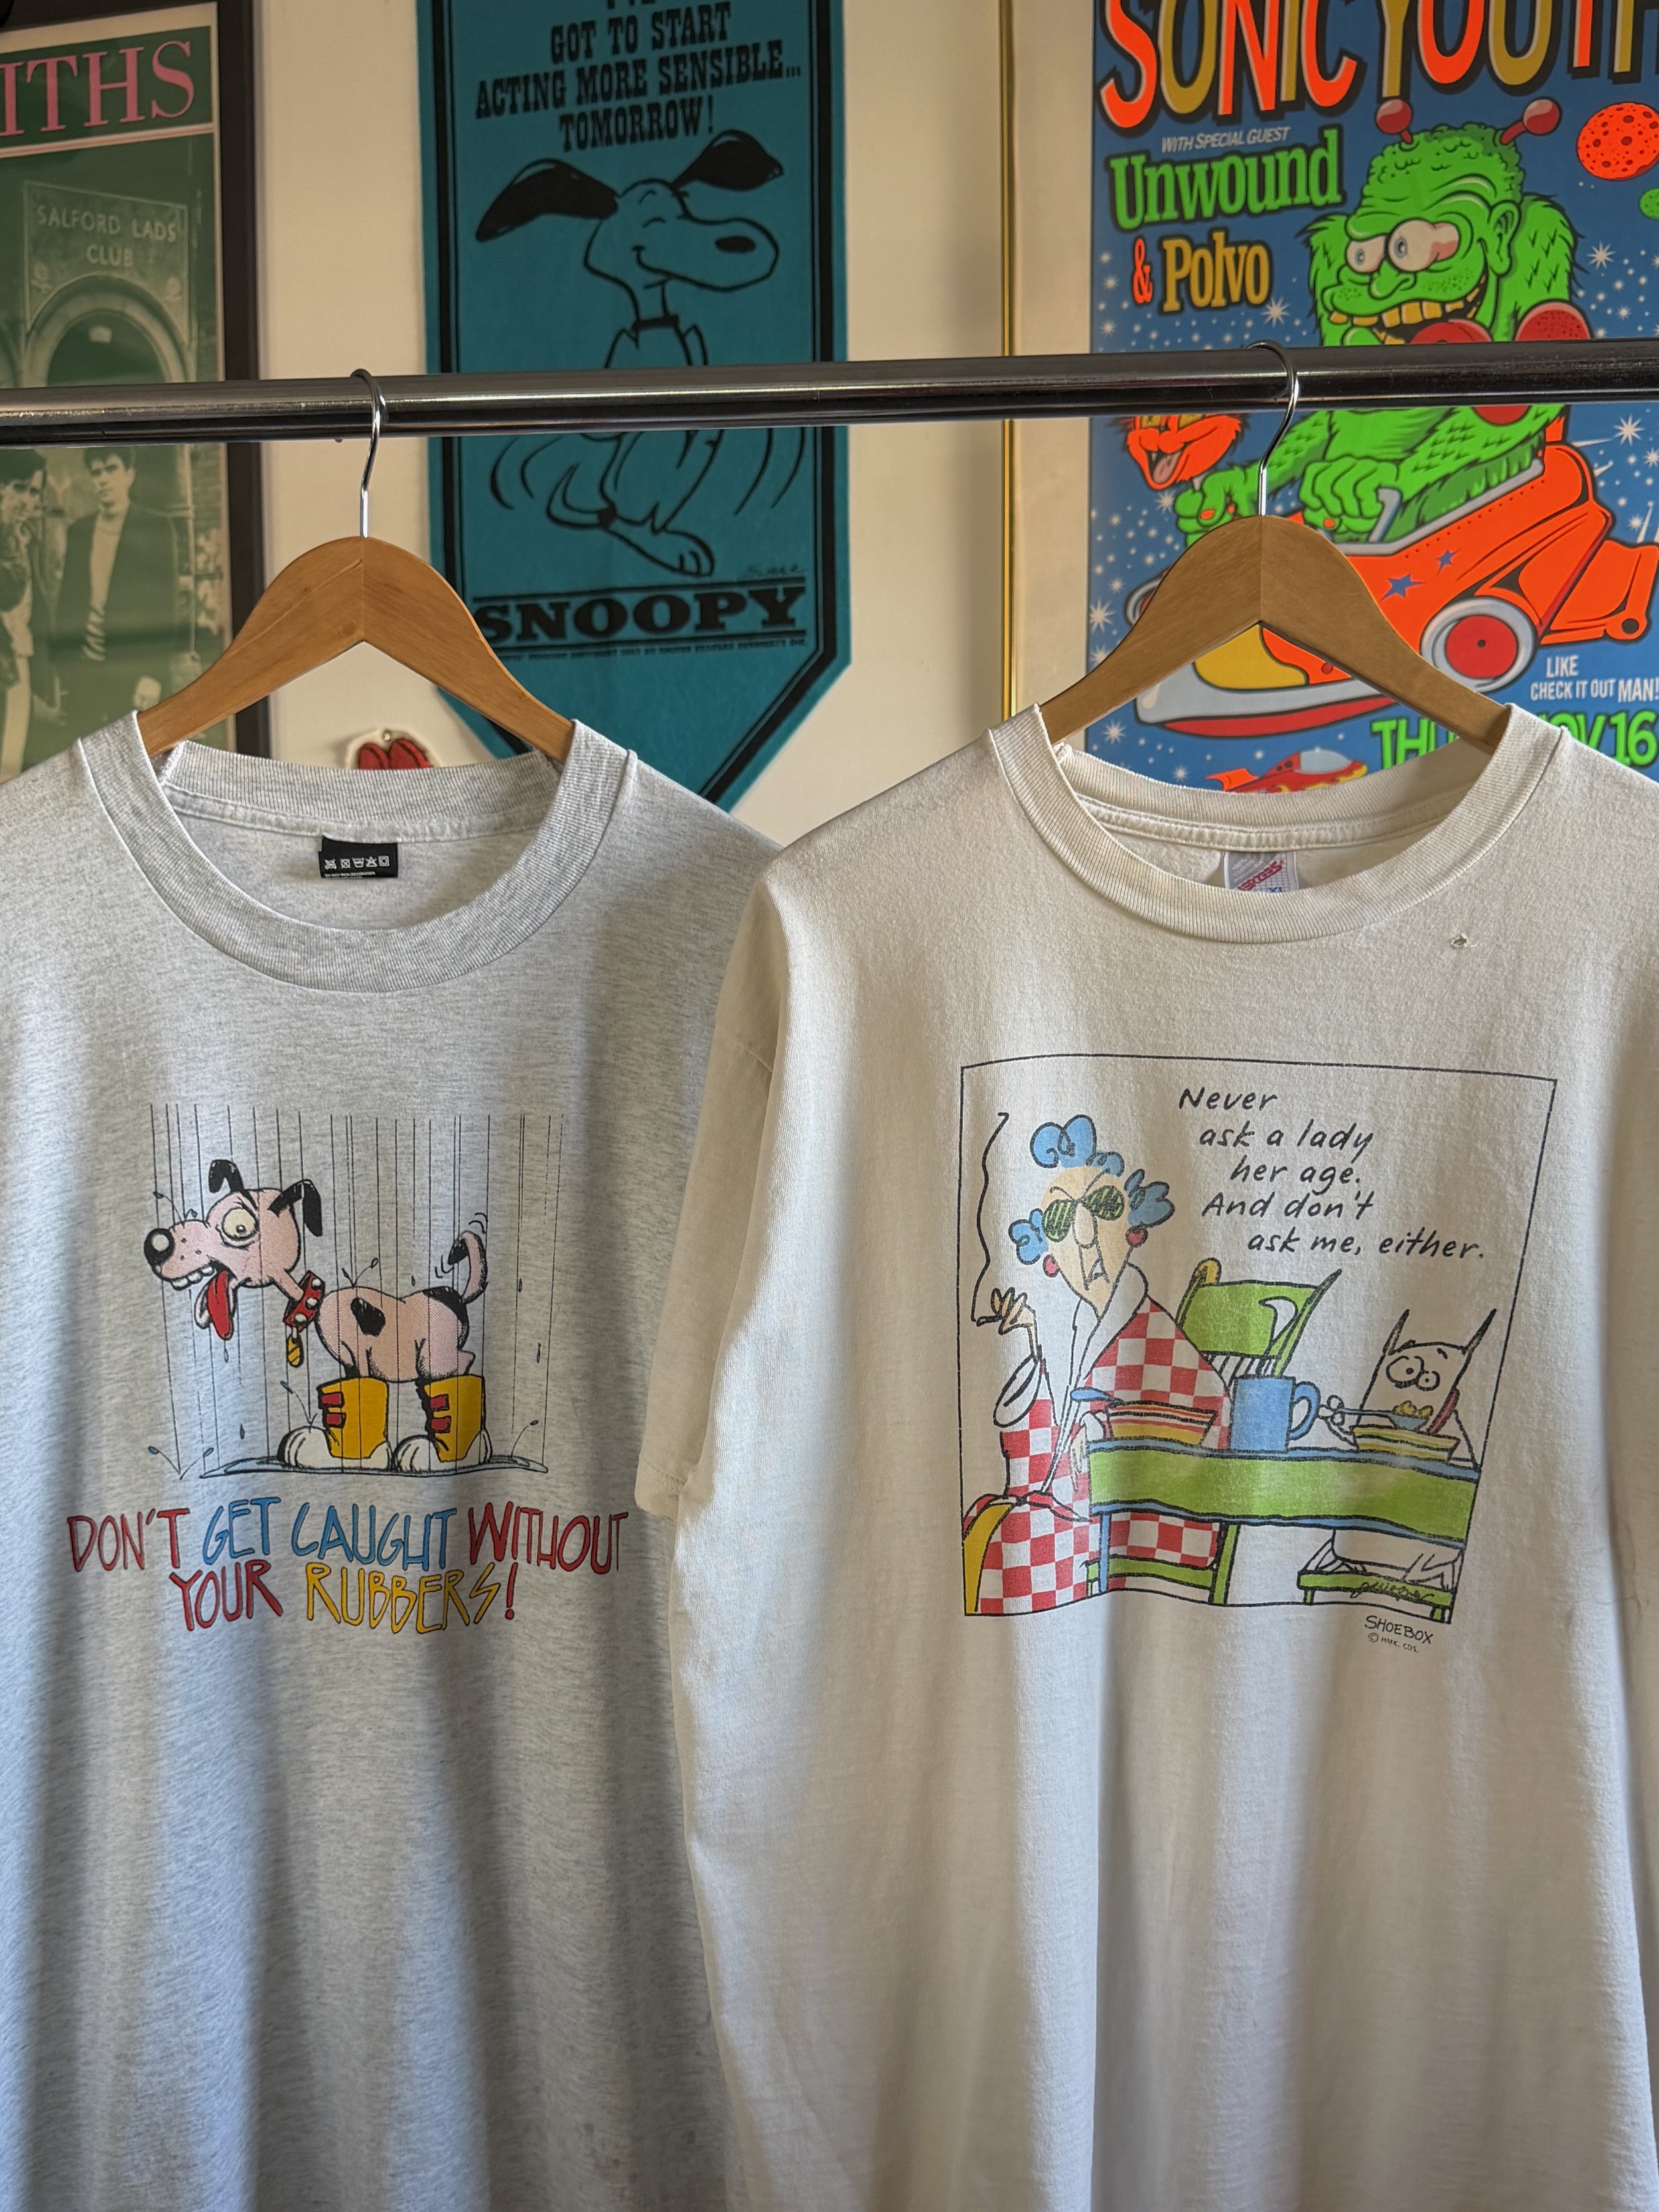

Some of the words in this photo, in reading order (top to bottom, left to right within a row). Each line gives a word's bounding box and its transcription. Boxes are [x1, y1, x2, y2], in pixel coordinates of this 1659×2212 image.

[551, 20, 596, 64] GOT
[608, 15, 638, 54] TO
[652, 1, 731, 50] START
[0, 40, 194, 137] ITHS
[476, 70, 566, 120] ACTING
[576, 58, 648, 105] MORE
[1100, 0, 1357, 128] SONIC
[559, 95, 713, 153] TOMORROW!
[1161, 136, 1194, 153] WITH
[1194, 129, 1246, 150] SPECIAL
[1246, 126, 1291, 144] GUEST
[1109, 128, 1342, 230] Unwound
[36, 204, 121, 236] SALFORD
[133, 219, 177, 243] LADS
[86, 243, 134, 267] CLUB
[1132, 238, 1153, 305] &
[1162, 230, 1271, 312] Polvo
[473, 587, 806, 644] SNOOPY
[1530, 679, 1573, 701] CHECK
[1575, 679, 1589, 699] IT
[1590, 677, 1616, 699] OUT
[1617, 677, 1659, 703] MAN!
[1545, 654, 1579, 679] LIKE
[1538, 712, 1607, 750] OV
[1609, 710, 1658, 766] 16
[1179, 1087, 1278, 1110] Never
[1199, 1120, 1255, 1147] ask
[1267, 1129, 1284, 1146] a
[1296, 1119, 1374, 1163] lady
[1230, 1155, 1287, 1183] her
[1299, 1162, 1361, 1194] age.
[1201, 1192, 1275, 1218] And
[1284, 1190, 1375, 1220] don't
[1247, 1226, 1300, 1253] ask
[1309, 1239, 1362, 1256] me,
[1379, 1226, 1484, 1259] either.
[67, 1507, 190, 1572] DON'T
[202, 1496, 282, 1566] GET
[291, 1501, 457, 1571] CAUGHT
[467, 1501, 629, 1575] WITHOUT
[168, 1559, 284, 1632] YOUR
[305, 1560, 519, 1634] RUBBERS!
[1364, 1615, 1433, 1645] SHOEBOX
